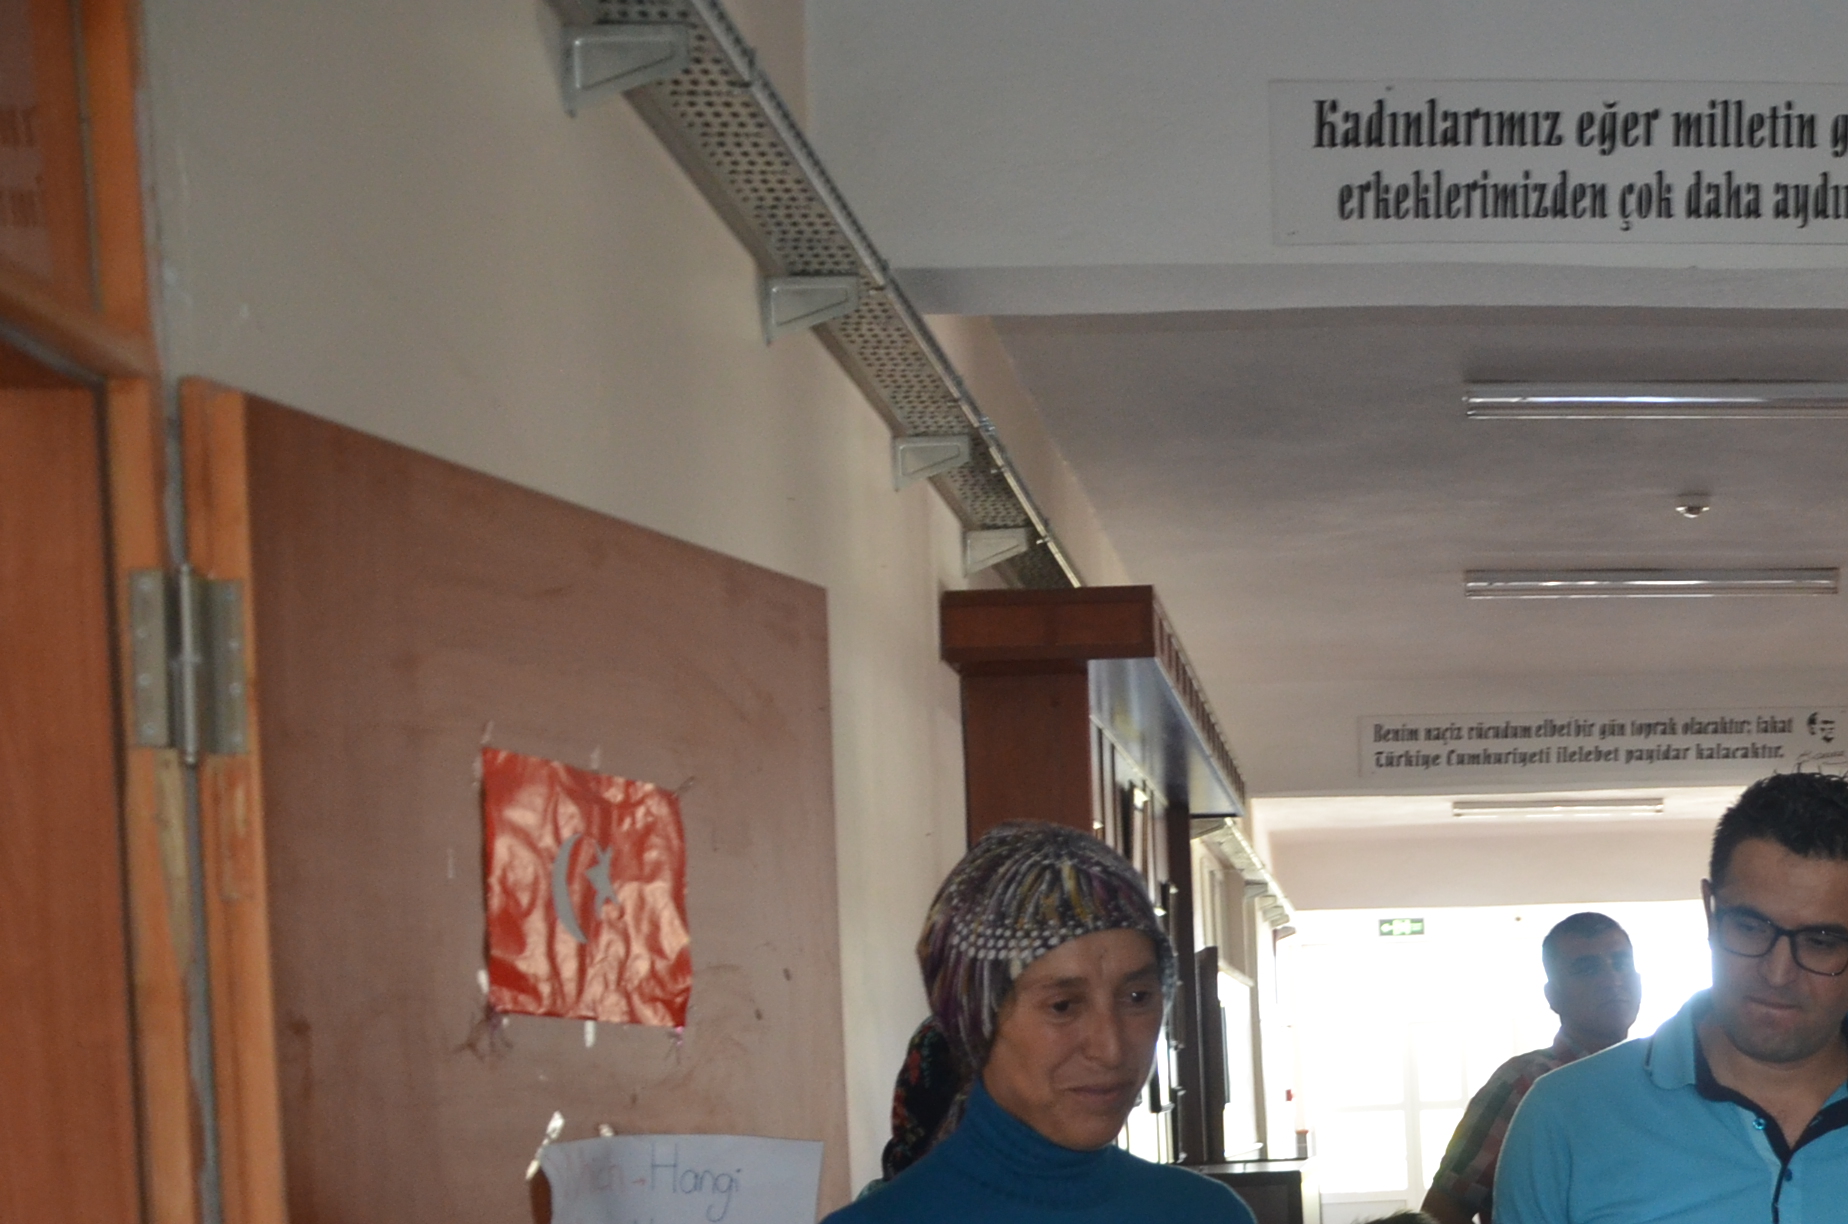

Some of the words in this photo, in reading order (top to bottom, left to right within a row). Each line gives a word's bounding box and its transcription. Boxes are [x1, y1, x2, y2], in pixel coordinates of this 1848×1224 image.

[1313, 98, 1564, 149] Kadınlarımız
[1576, 100, 1660, 156] eğer
[1671, 98, 1817, 149] milletin
[1338, 169, 1608, 220] erkeklerimizden
[1618, 171, 1674, 231] çok
[1684, 171, 1761, 220] daha
[1373, 723, 1419, 743] Benim
[1424, 722, 1462, 745] naçiz
[1574, 718, 1596, 739] bir
[1598, 718, 1626, 740] gün
[1630, 717, 1678, 739] toprak
[1374, 749, 1441, 770] Türkiye
[1445, 746, 1552, 768] Cumhuriyeti
[1556, 745, 1620, 764] ilelebet
[1624, 744, 1691, 765] payidar
[650, 1141, 742, 1223] Hangi
